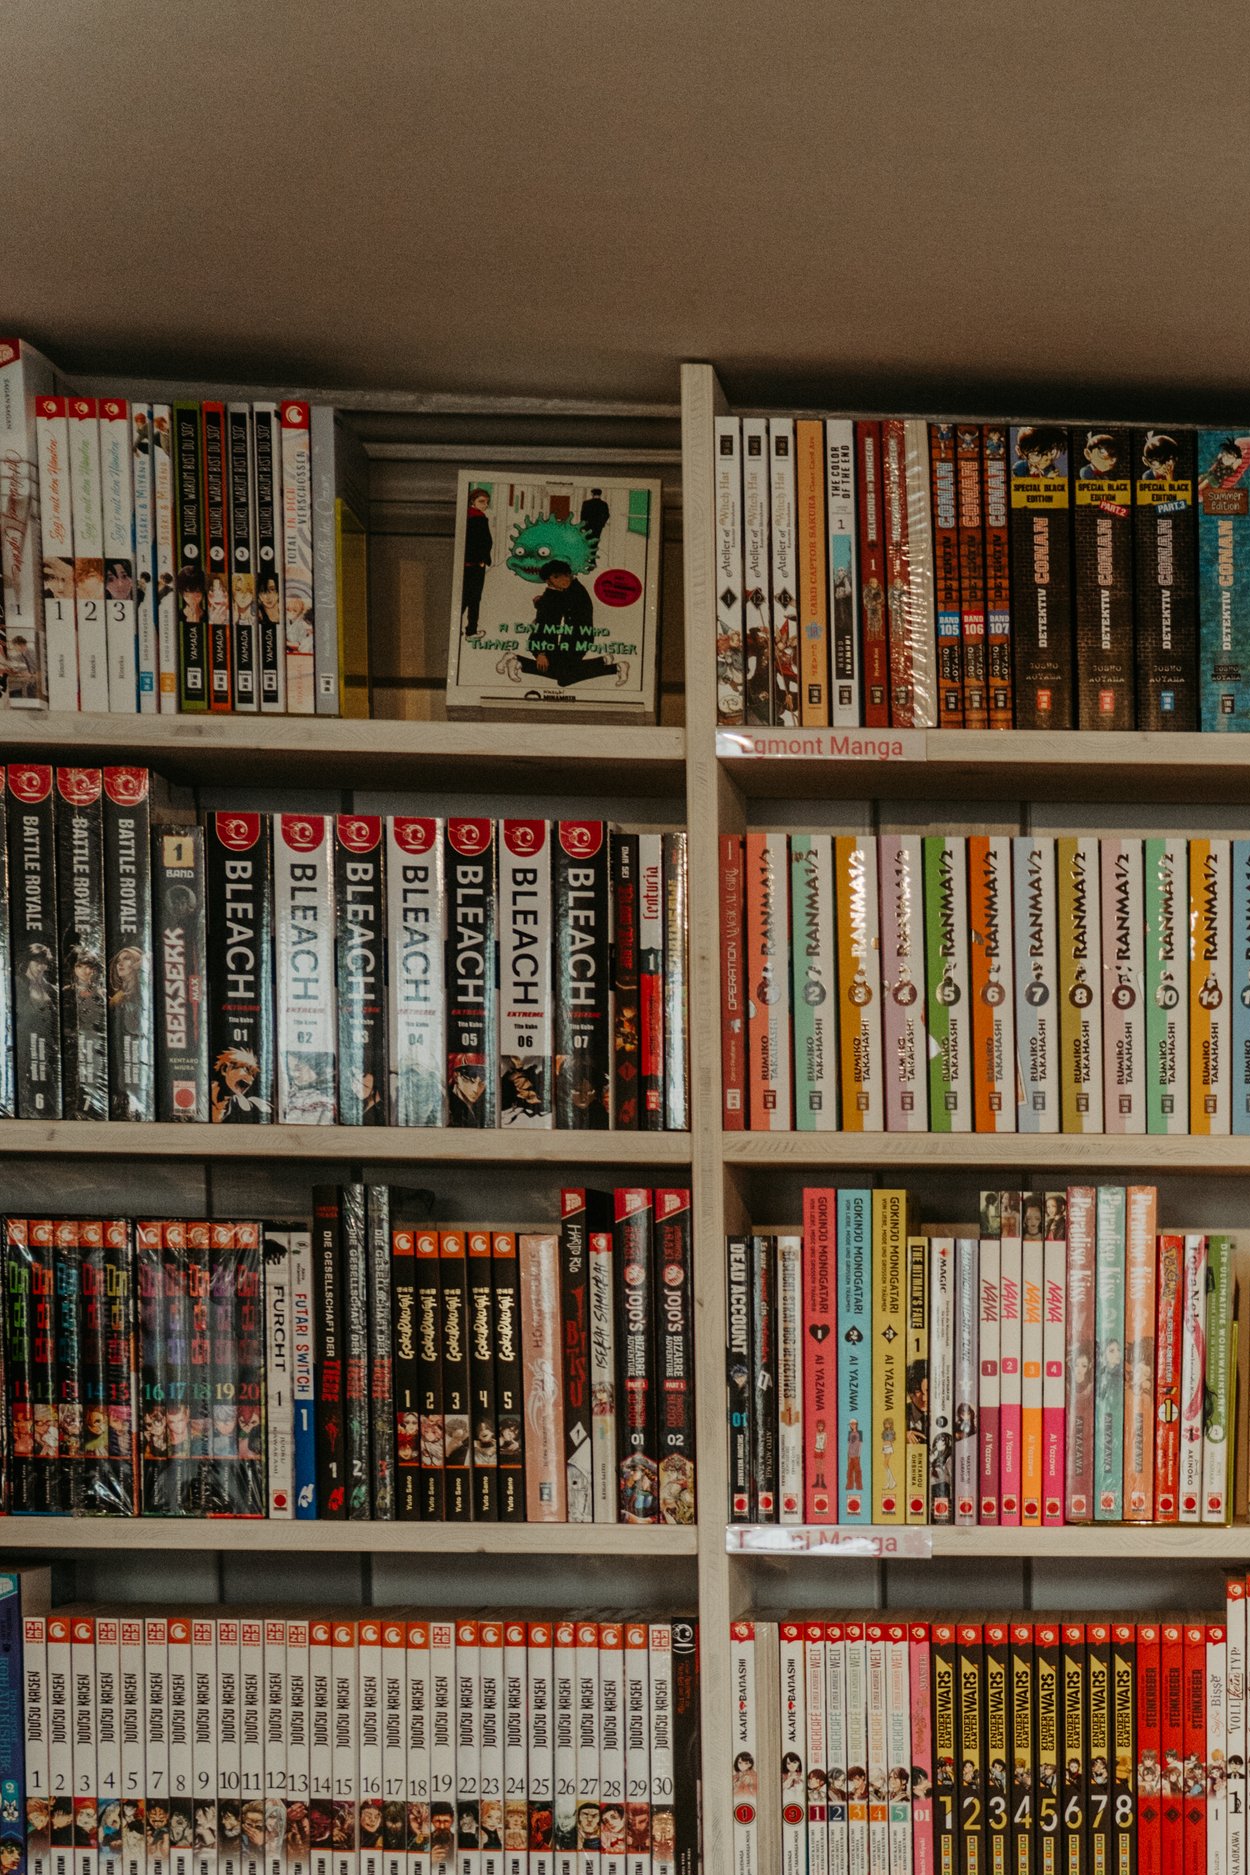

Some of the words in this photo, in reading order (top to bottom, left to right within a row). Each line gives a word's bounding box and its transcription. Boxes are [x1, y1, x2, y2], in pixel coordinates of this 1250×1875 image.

[831, 446, 840, 477] COLOR
[841, 445, 850, 461] END
[832, 480, 840, 497] THE
[841, 465, 850, 484] THE
[1013, 483, 1040, 492] SPECIAL
[1043, 483, 1066, 492] BLACK
[842, 486, 850, 499] OF
[1026, 494, 1054, 503] EDITION
[1208, 491, 1243, 501] Summer
[1034, 517, 1049, 584] CONAN
[55, 602, 64, 620] 1
[84, 602, 98, 620] 2
[113, 602, 125, 622] 3
[1037, 589, 1048, 648] DETEKTIV
[190, 628, 198, 661] YAMADA
[514, 624, 539, 634] GAY
[830, 731, 904, 756] Manga
[23, 816, 41, 873] BATTLE
[166, 869, 194, 878] BAND
[25, 876, 42, 931] ROYALE
[225, 860, 255, 998] BLEACH
[456, 865, 485, 1002] BLEACH
[511, 868, 539, 1005] BLEACH
[164, 928, 187, 1049] BERSERK
[191, 977, 199, 1001] MAX
[1033, 988, 1043, 998] 7
[233, 1029, 248, 1042] 01
[462, 1032, 478, 1046] 05
[518, 1035, 533, 1048] 06
[1039, 1019, 1047, 1082] TAKAHASHI
[1030, 1037, 1038, 1082] RUMIKO
[818, 1197, 827, 1240] GOKINJO
[729, 1243, 745, 1278] DEAD
[818, 1243, 829, 1314] MONOGATARI
[295, 1293, 308, 1342] FUTARI
[625, 1288, 644, 1331] JOJO'S
[730, 1281, 748, 1353] ACCOUNT
[1047, 1280, 1063, 1324] NANA
[273, 1286, 287, 1373] FURCHT
[296, 1345, 309, 1394] SWITCH
[628, 1335, 636, 1376] ADVENTURE
[635, 1336, 645, 1377] BIZARRE
[815, 1355, 823, 1365] AI
[815, 1370, 824, 1411] YAZAWA
[631, 1435, 644, 1445] 01
[32, 1671, 40, 1702] KAISEN
[28, 1705, 43, 1742] JUJUTSU
[32, 1771, 42, 1788] 1
[219, 1771, 239, 1789] 10
[1041, 1798, 1057, 1832] 5
[1115, 1795, 1133, 1828] 8
[1232, 1831, 1240, 1864] AOKAWA
